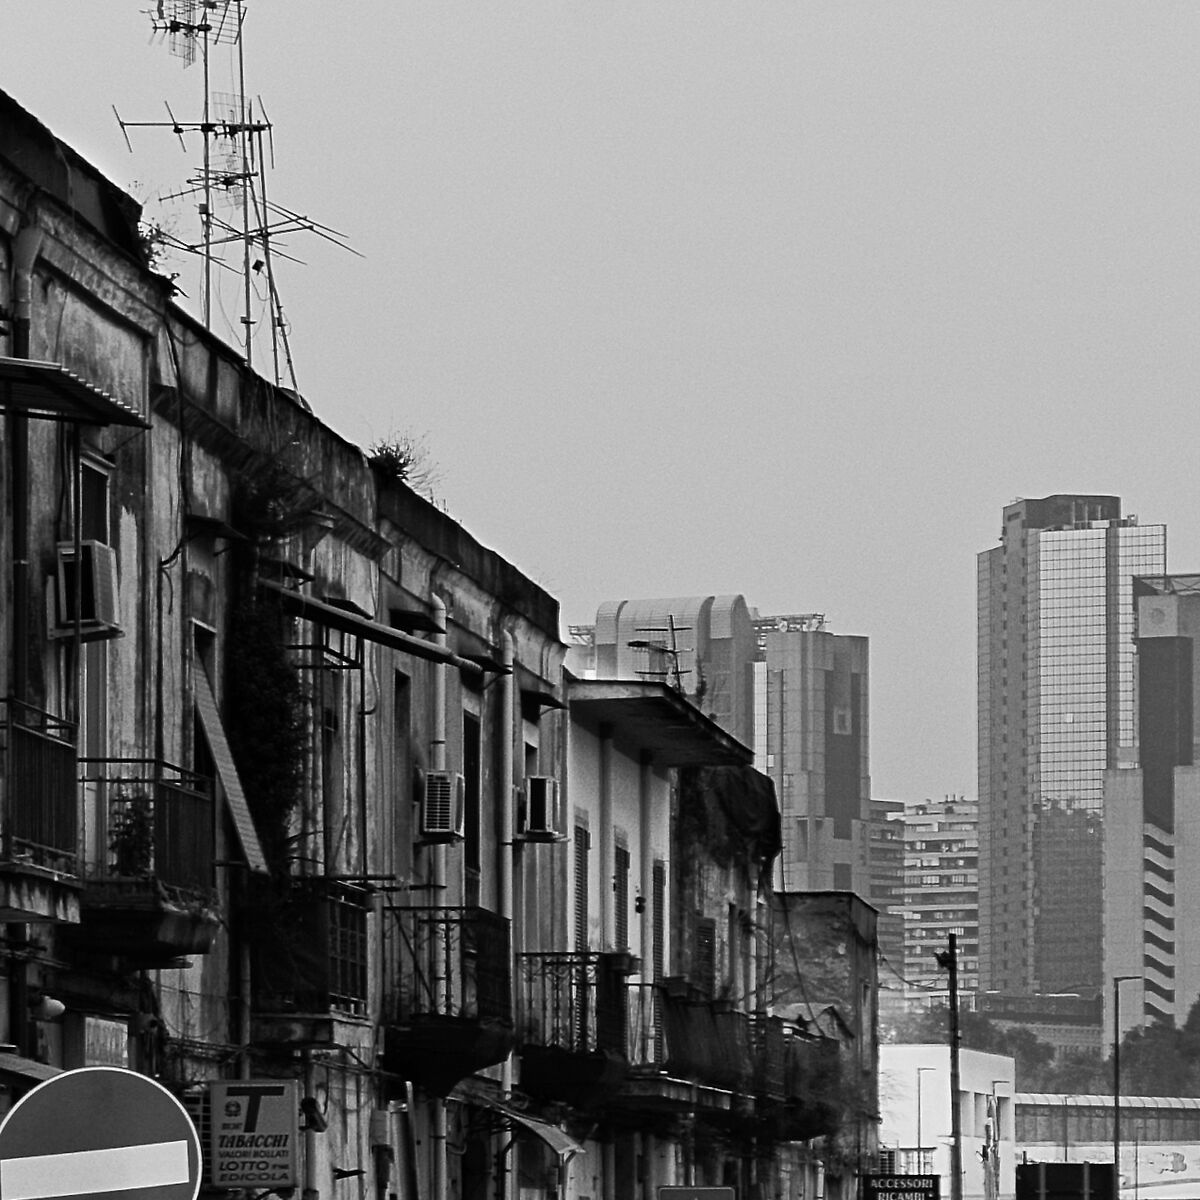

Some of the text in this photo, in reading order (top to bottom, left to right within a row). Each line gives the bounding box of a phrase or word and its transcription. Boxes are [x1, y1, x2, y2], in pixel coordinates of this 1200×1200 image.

[226, 1085, 285, 1133] T
[218, 1134, 289, 1148] TABACCHI
[218, 1150, 252, 1158] VALORI
[219, 1160, 270, 1171] LOTTO
[219, 1172, 290, 1182] EDICOLA
[871, 1178, 933, 1188] ACCESSORI
